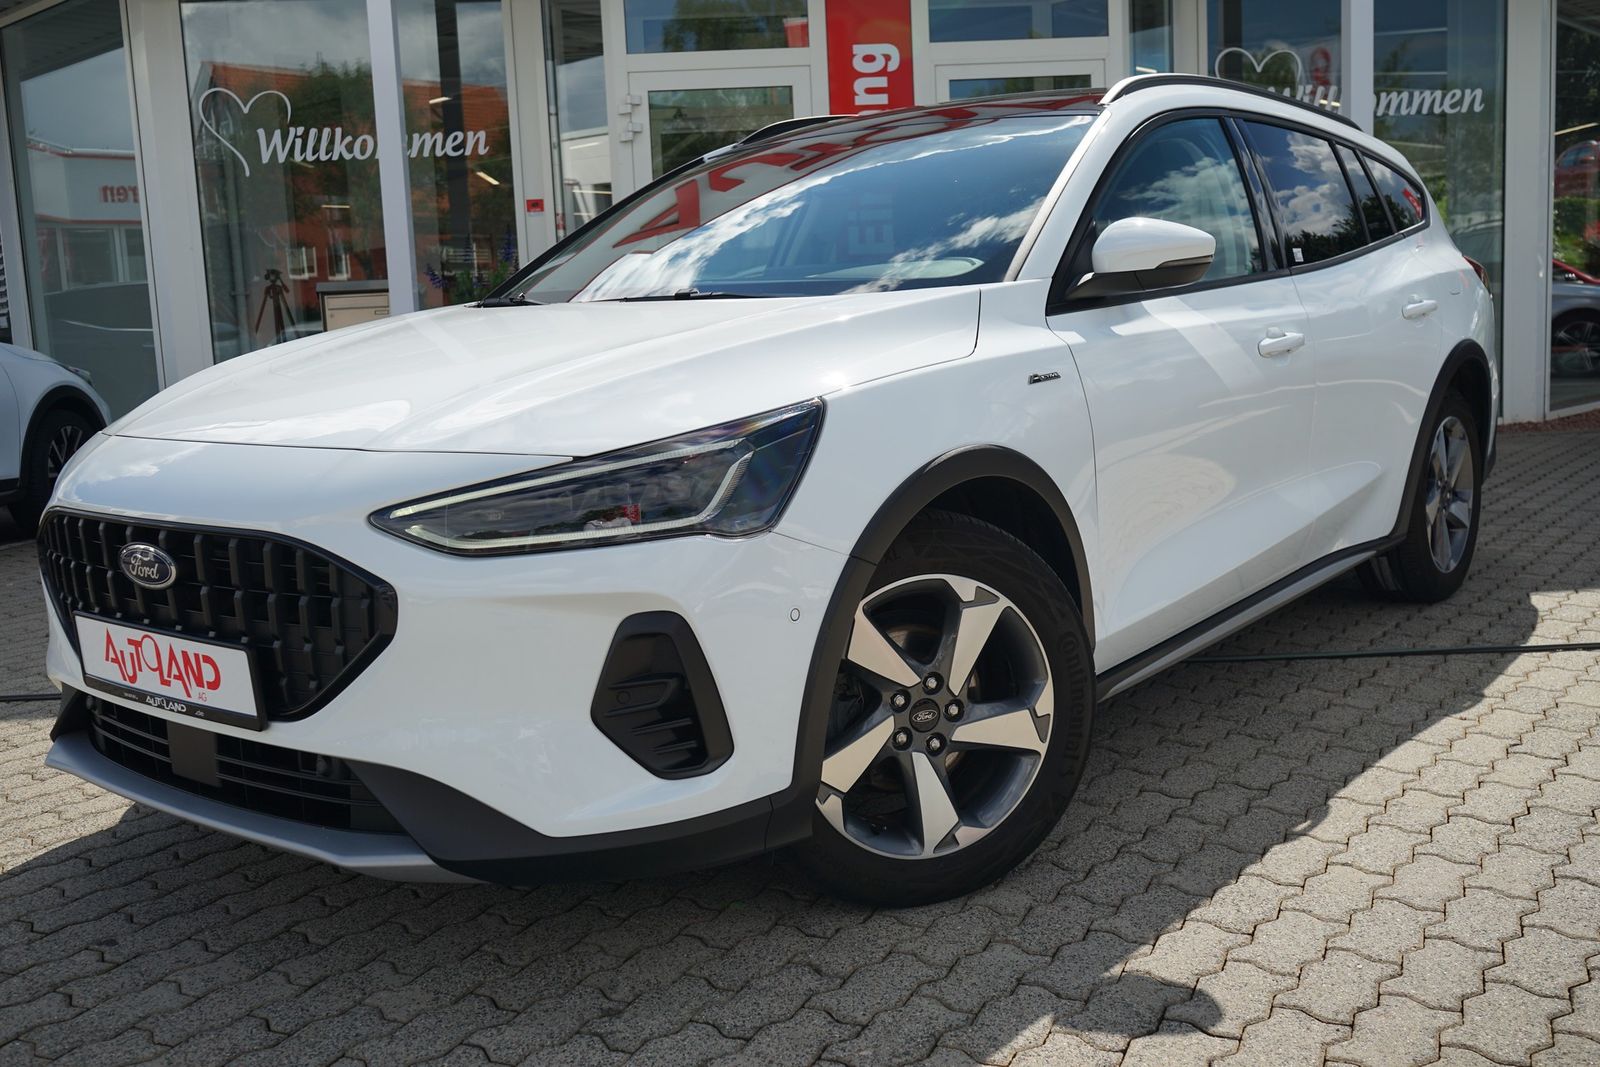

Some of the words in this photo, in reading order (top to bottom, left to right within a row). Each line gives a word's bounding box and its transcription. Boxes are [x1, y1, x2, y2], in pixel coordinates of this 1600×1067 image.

[257, 126, 489, 165] Willkomen
[129, 553, 160, 580] Ford
[104, 627, 222, 699] AUTOLAND
